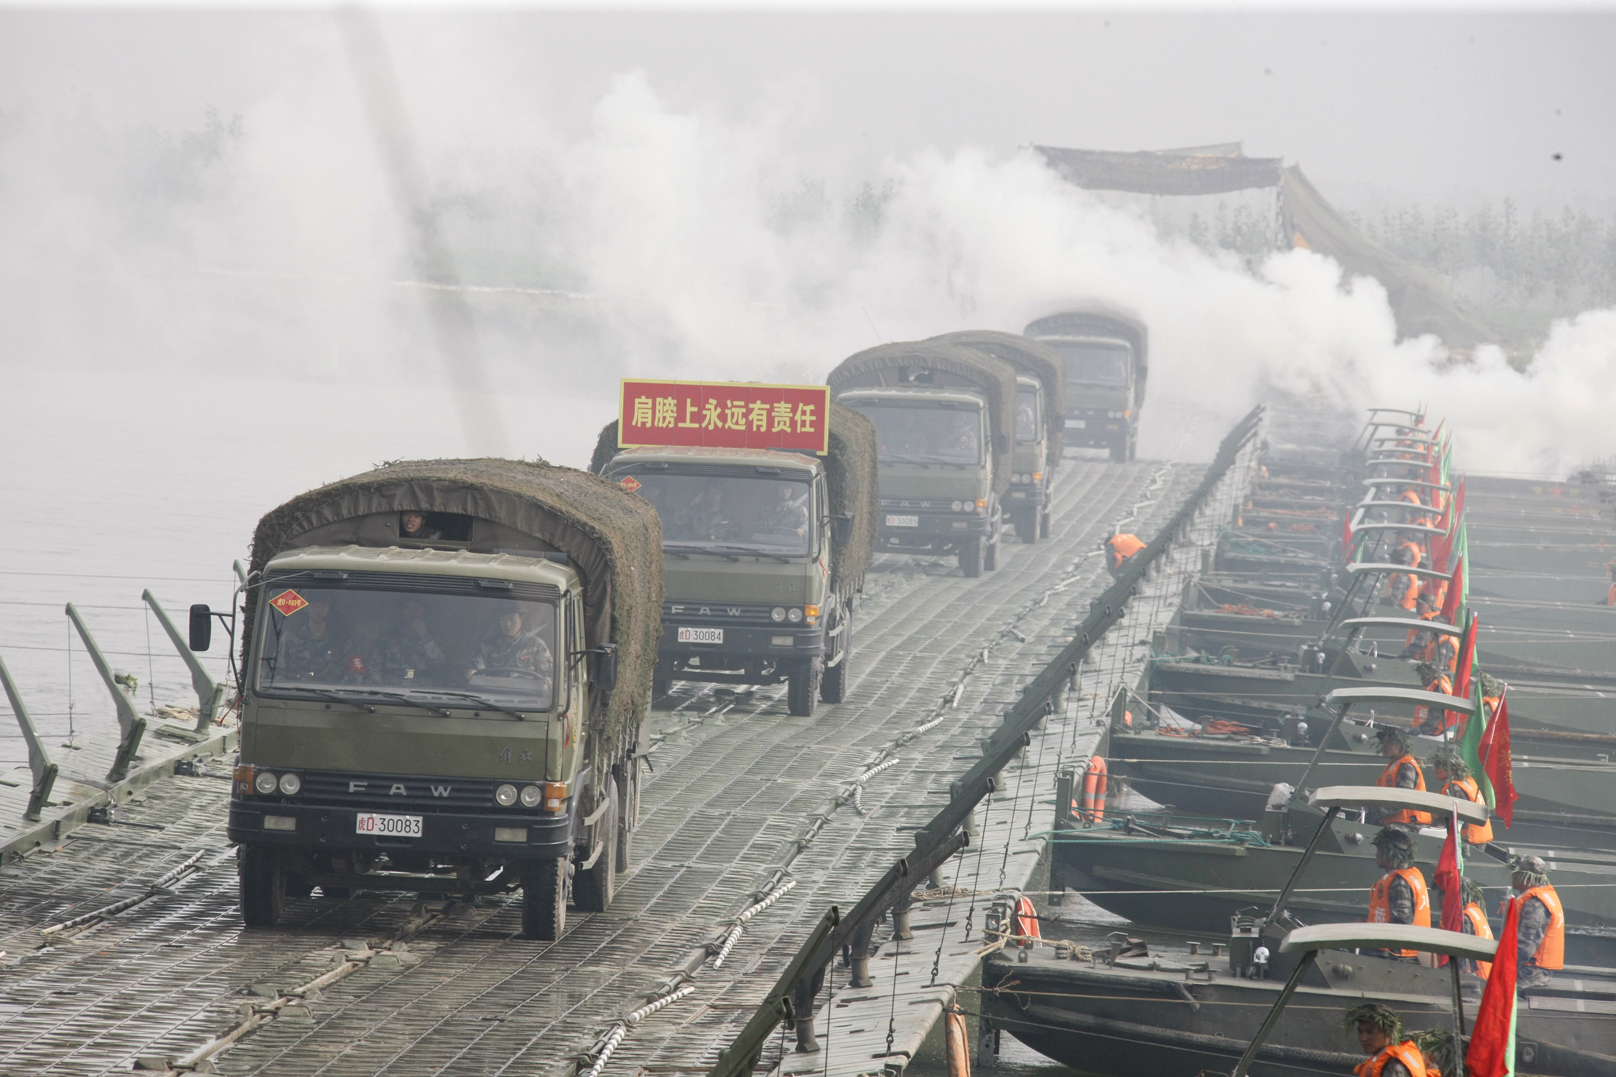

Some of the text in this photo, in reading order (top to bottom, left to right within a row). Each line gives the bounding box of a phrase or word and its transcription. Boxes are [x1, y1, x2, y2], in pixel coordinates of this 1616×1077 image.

[631, 395, 816, 433] 肩膀上永远有责任
[671, 605, 741, 617] FAW
[348, 781, 452, 798] FAW
